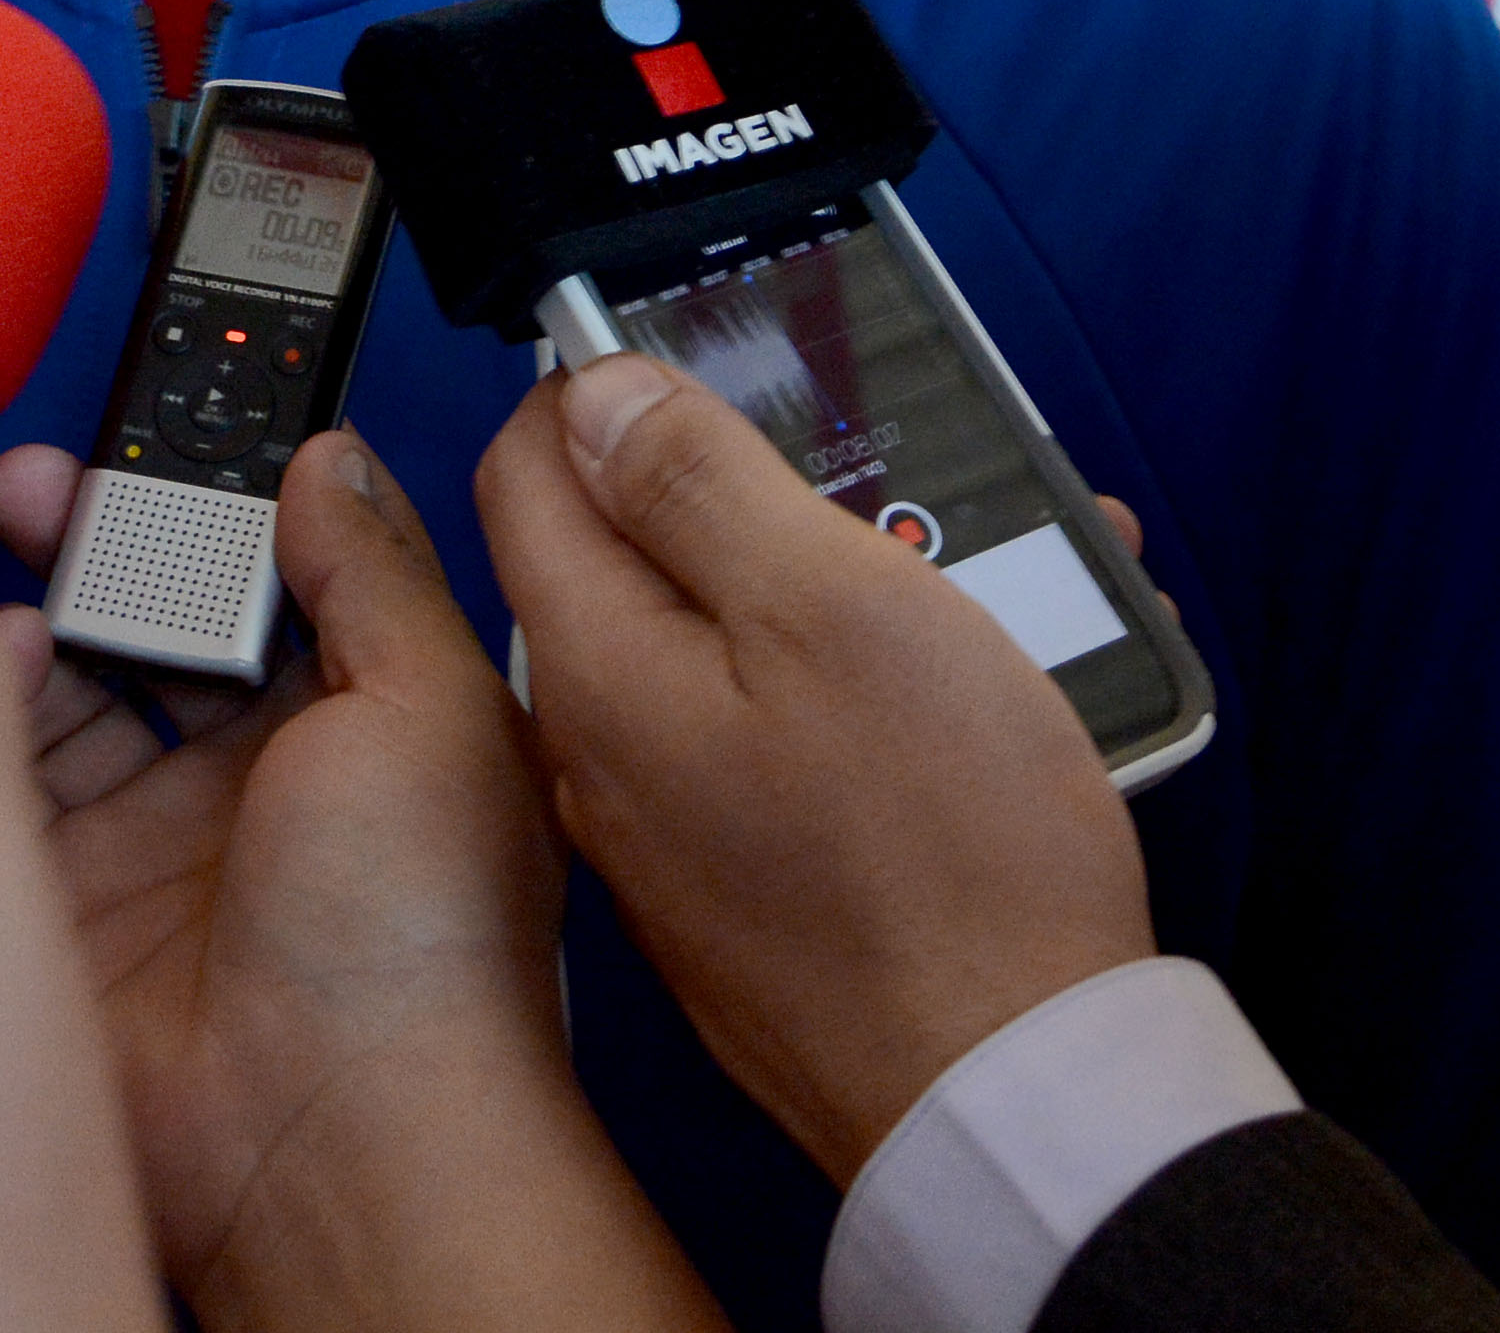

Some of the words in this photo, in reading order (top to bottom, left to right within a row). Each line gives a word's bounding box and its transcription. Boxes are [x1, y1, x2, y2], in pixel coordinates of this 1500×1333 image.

[613, 103, 815, 183] IMAGEN
[241, 171, 305, 208] REC
[168, 273, 203, 287] DIGITAL
[205, 280, 231, 292] VOICE
[233, 284, 281, 300] RECORDER
[169, 292, 206, 309] STOP
[290, 314, 316, 329] REC
